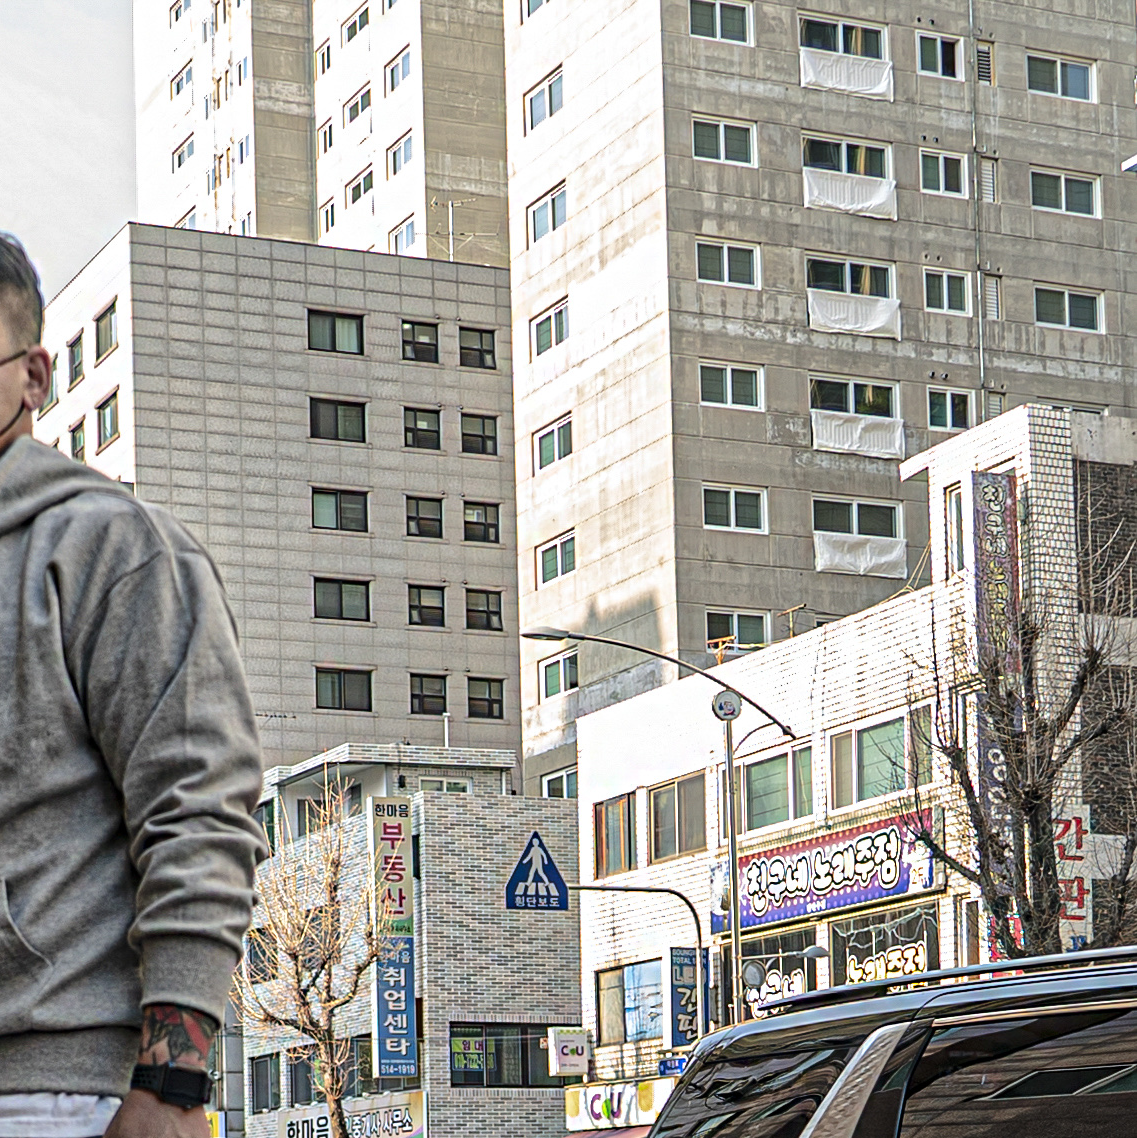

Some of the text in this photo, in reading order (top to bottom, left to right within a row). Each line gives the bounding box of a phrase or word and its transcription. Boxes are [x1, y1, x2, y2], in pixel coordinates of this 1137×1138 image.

[375, 803, 409, 818] 한마음
[380, 822, 406, 915] 부동산
[746, 855, 811, 916] 친구네
[515, 896, 560, 907] 횡단보도
[382, 966, 411, 1056] 취업센타
[383, 1108, 413, 1136] 사무소
